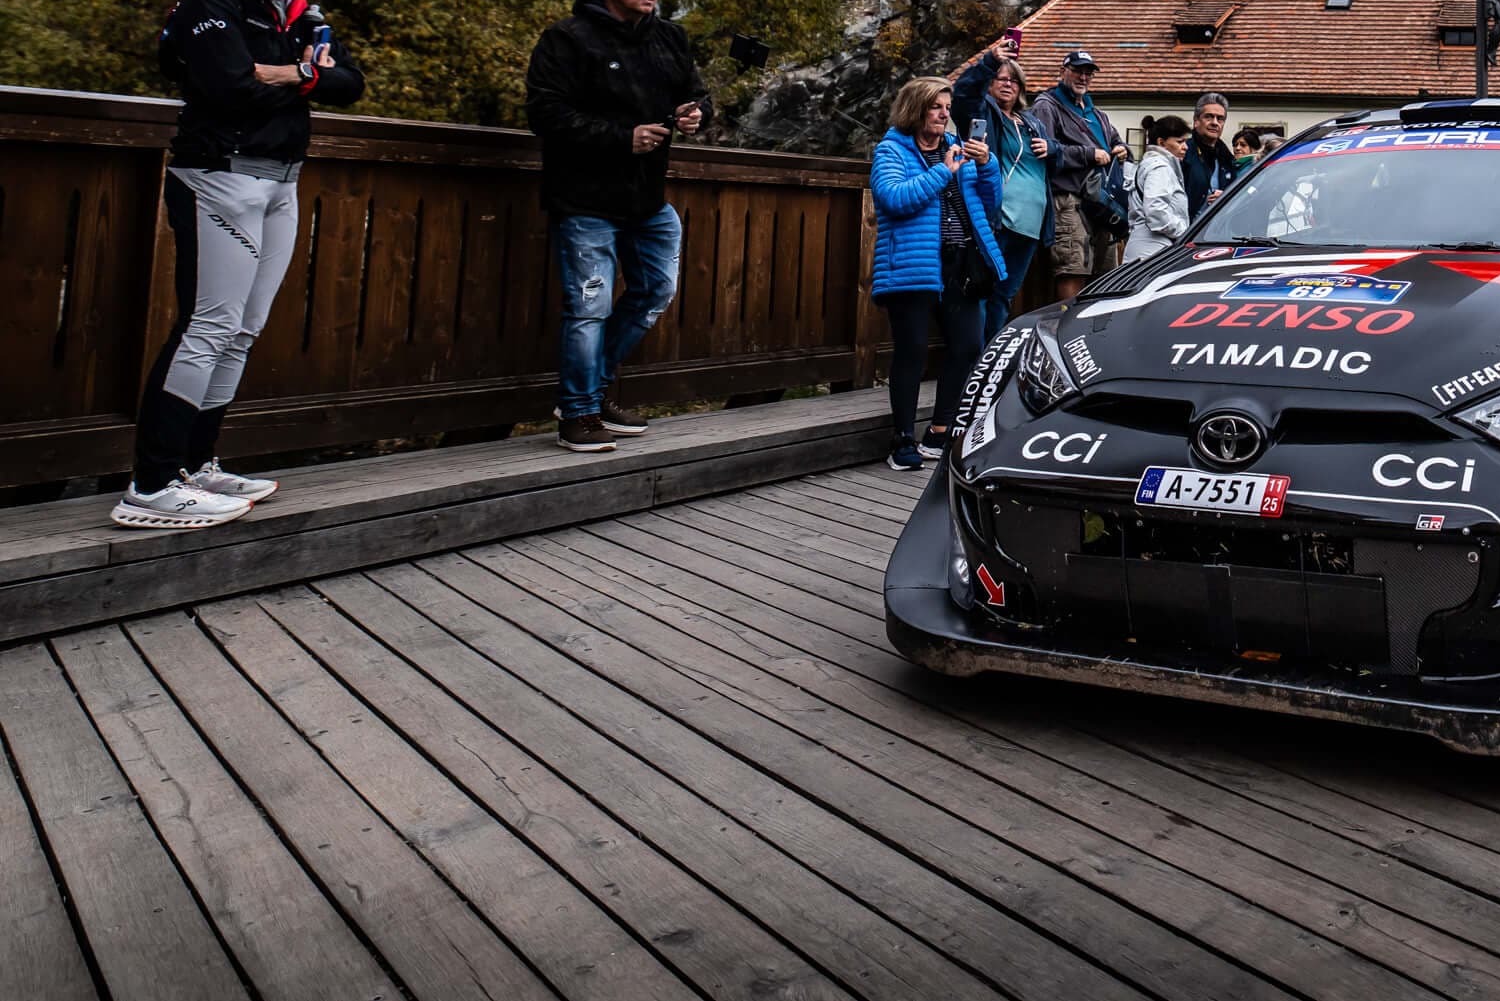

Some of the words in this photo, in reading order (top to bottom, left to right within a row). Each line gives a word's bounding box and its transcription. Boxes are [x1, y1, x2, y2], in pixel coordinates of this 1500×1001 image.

[1371, 121, 1457, 132] TOYOTA
[1287, 286, 1334, 298] 69
[1168, 303, 1416, 335] DENSO
[1170, 343, 1372, 375] TAMADIC
[952, 327, 1017, 438] AUTOMOTIVE
[1165, 475, 1256, 506] A-7551
[1270, 479, 1283, 493] 11
[1141, 489, 1155, 499] FIN
[1263, 497, 1279, 512] 25
